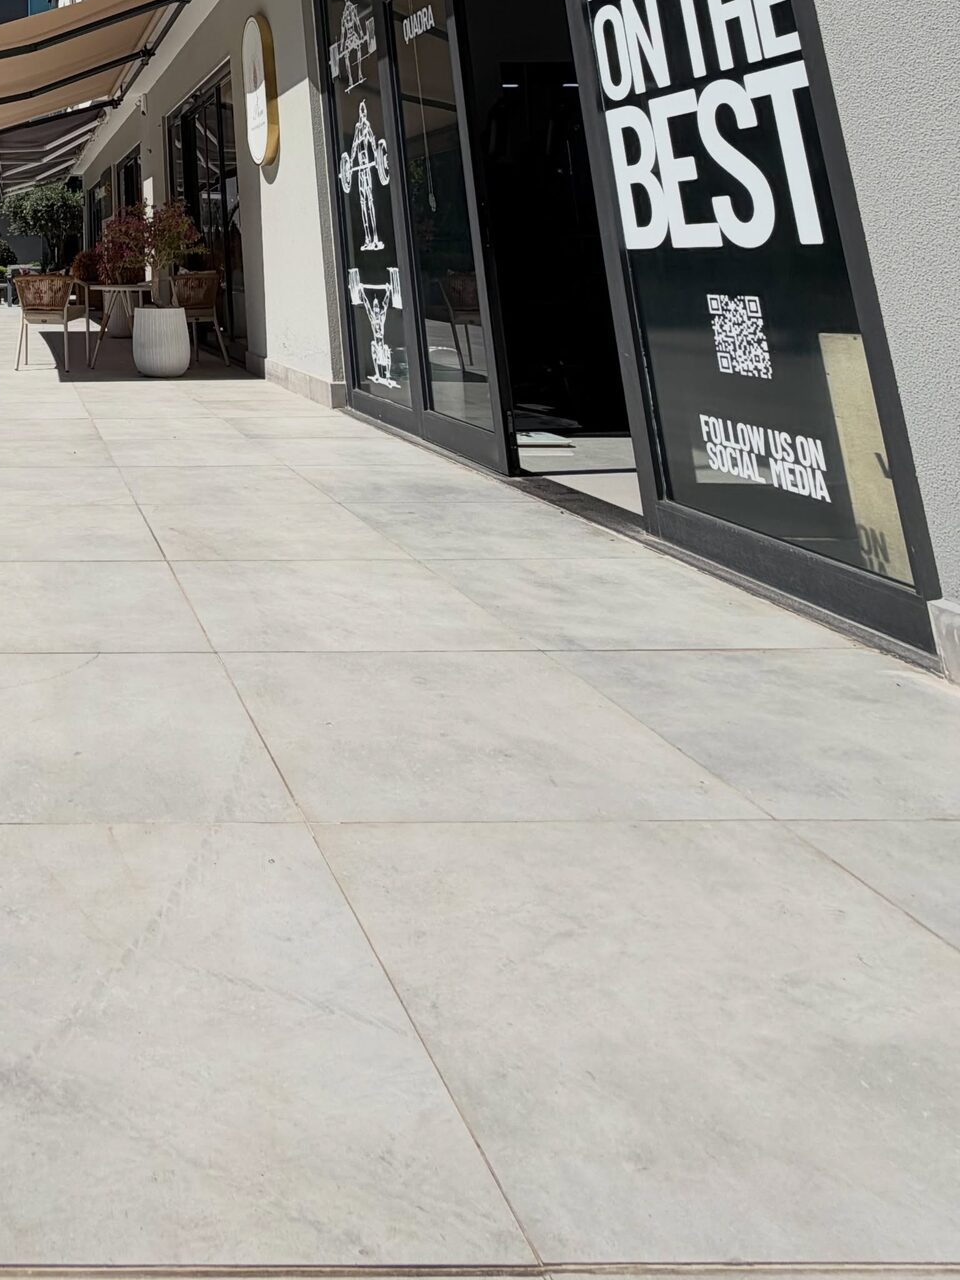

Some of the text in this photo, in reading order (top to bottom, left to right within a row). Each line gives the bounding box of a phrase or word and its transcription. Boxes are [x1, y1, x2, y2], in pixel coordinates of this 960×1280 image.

[402, 4, 435, 44] QUADRA
[605, 60, 824, 250] BEST
[699, 414, 827, 472] FOLLOW US ON
[705, 441, 832, 503] SOCIAL MEDIA
